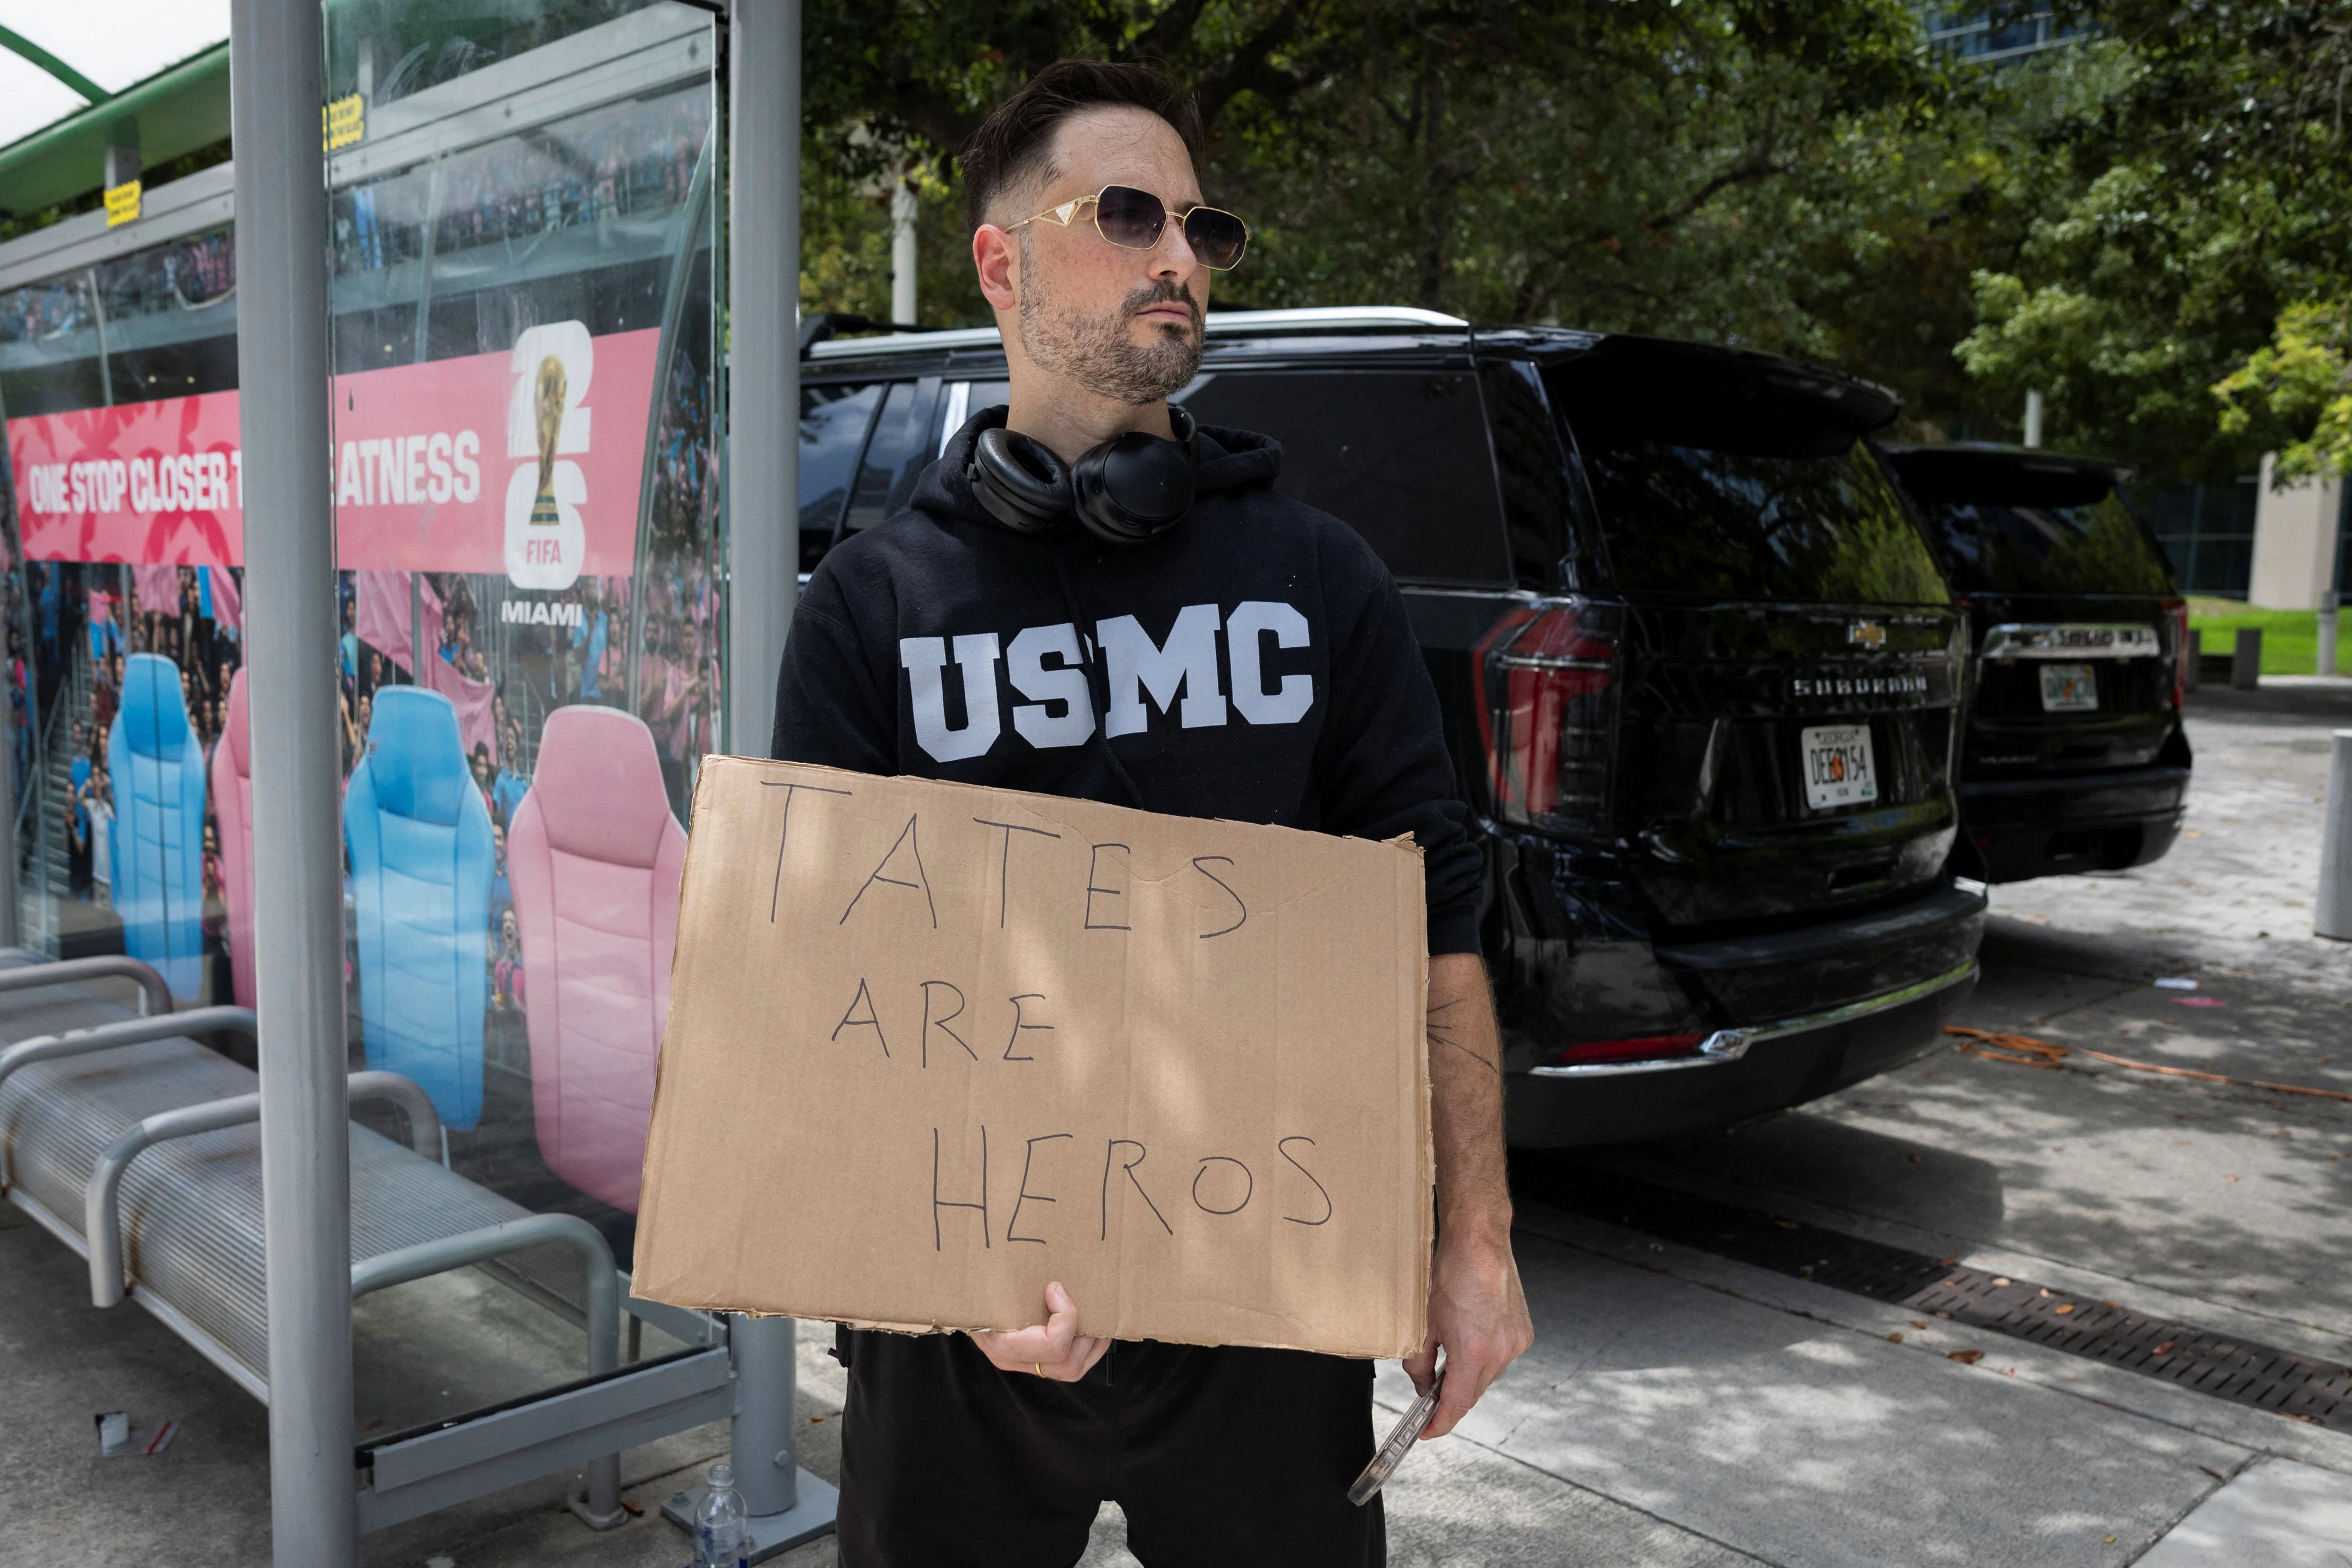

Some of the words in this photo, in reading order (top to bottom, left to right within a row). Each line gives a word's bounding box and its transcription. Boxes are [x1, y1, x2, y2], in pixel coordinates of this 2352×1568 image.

[29, 462, 71, 514] ONE
[70, 459, 126, 514] STOP
[129, 451, 230, 513] CLOSER
[329, 429, 481, 506] ATNESS
[526, 539, 562, 564] FIFA
[502, 600, 582, 626] MIAMI
[900, 601, 1314, 763] USMC
[760, 780, 1247, 939] TATES
[831, 977, 1055, 1069] ARE
[933, 1124, 1332, 1251] HEROS
